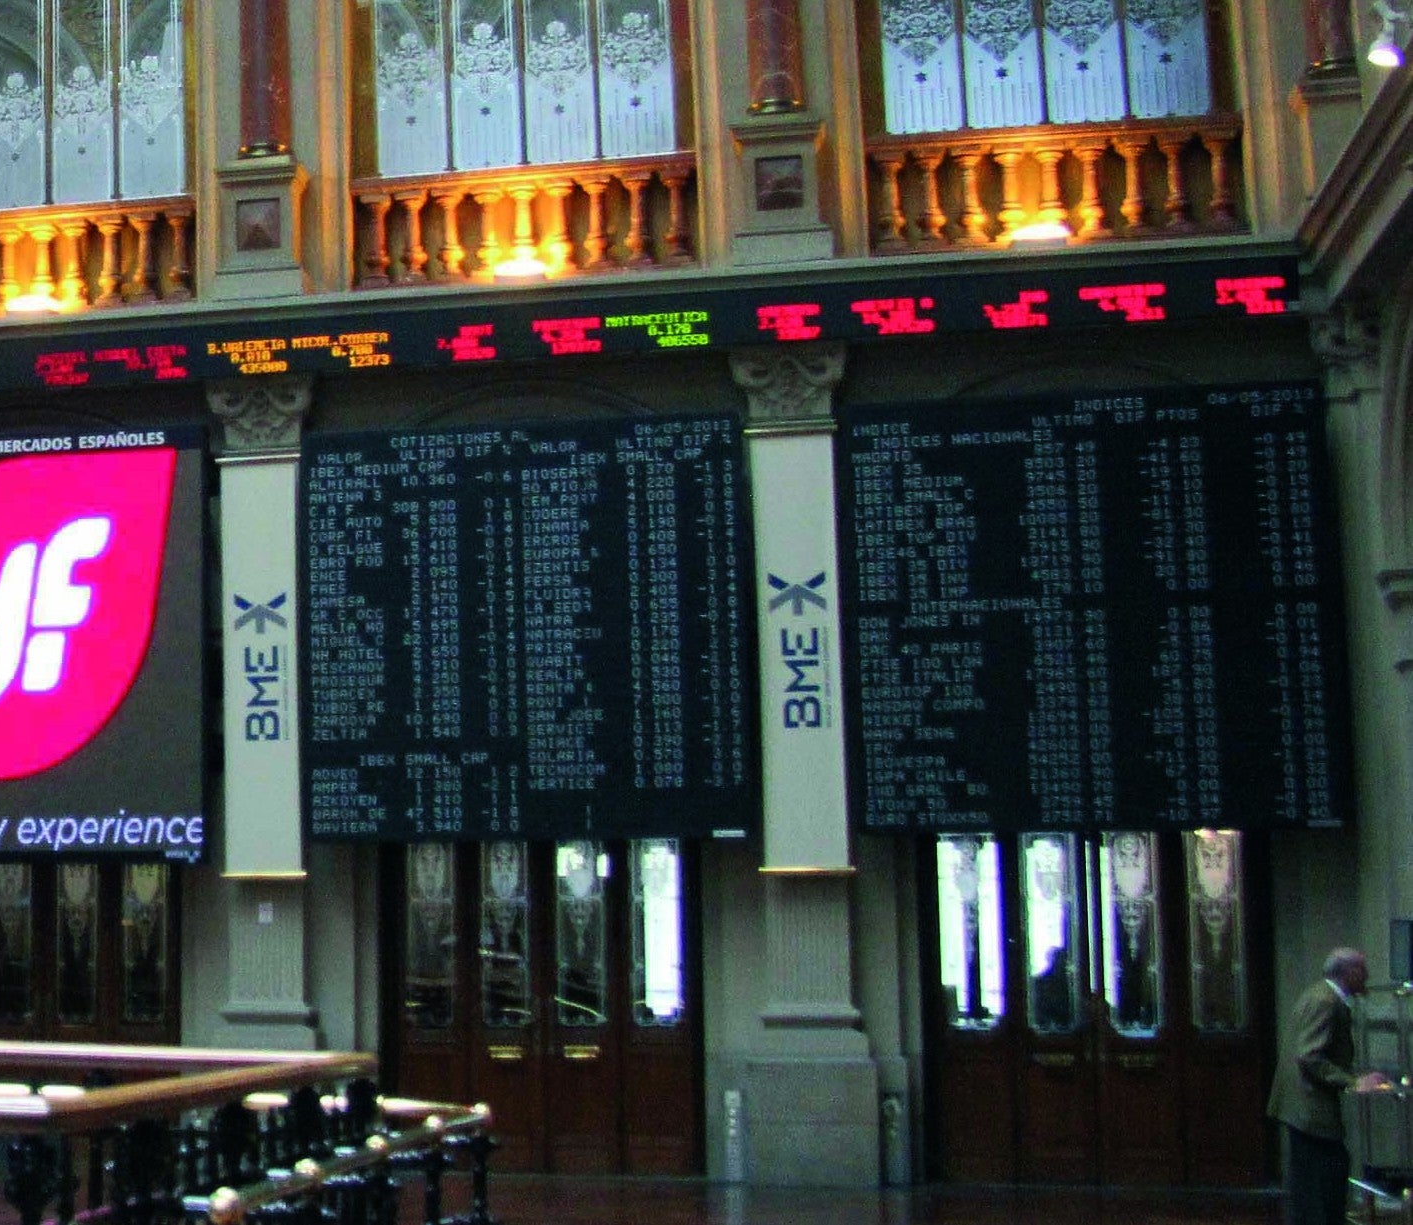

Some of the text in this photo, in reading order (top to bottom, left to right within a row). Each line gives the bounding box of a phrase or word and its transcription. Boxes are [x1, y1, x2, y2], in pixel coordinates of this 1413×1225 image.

[79, 431, 164, 448] ESPAÑOLES
[244, 645, 279, 741] BME
[781, 627, 822, 729] BME
[18, 810, 202, 850] experience
